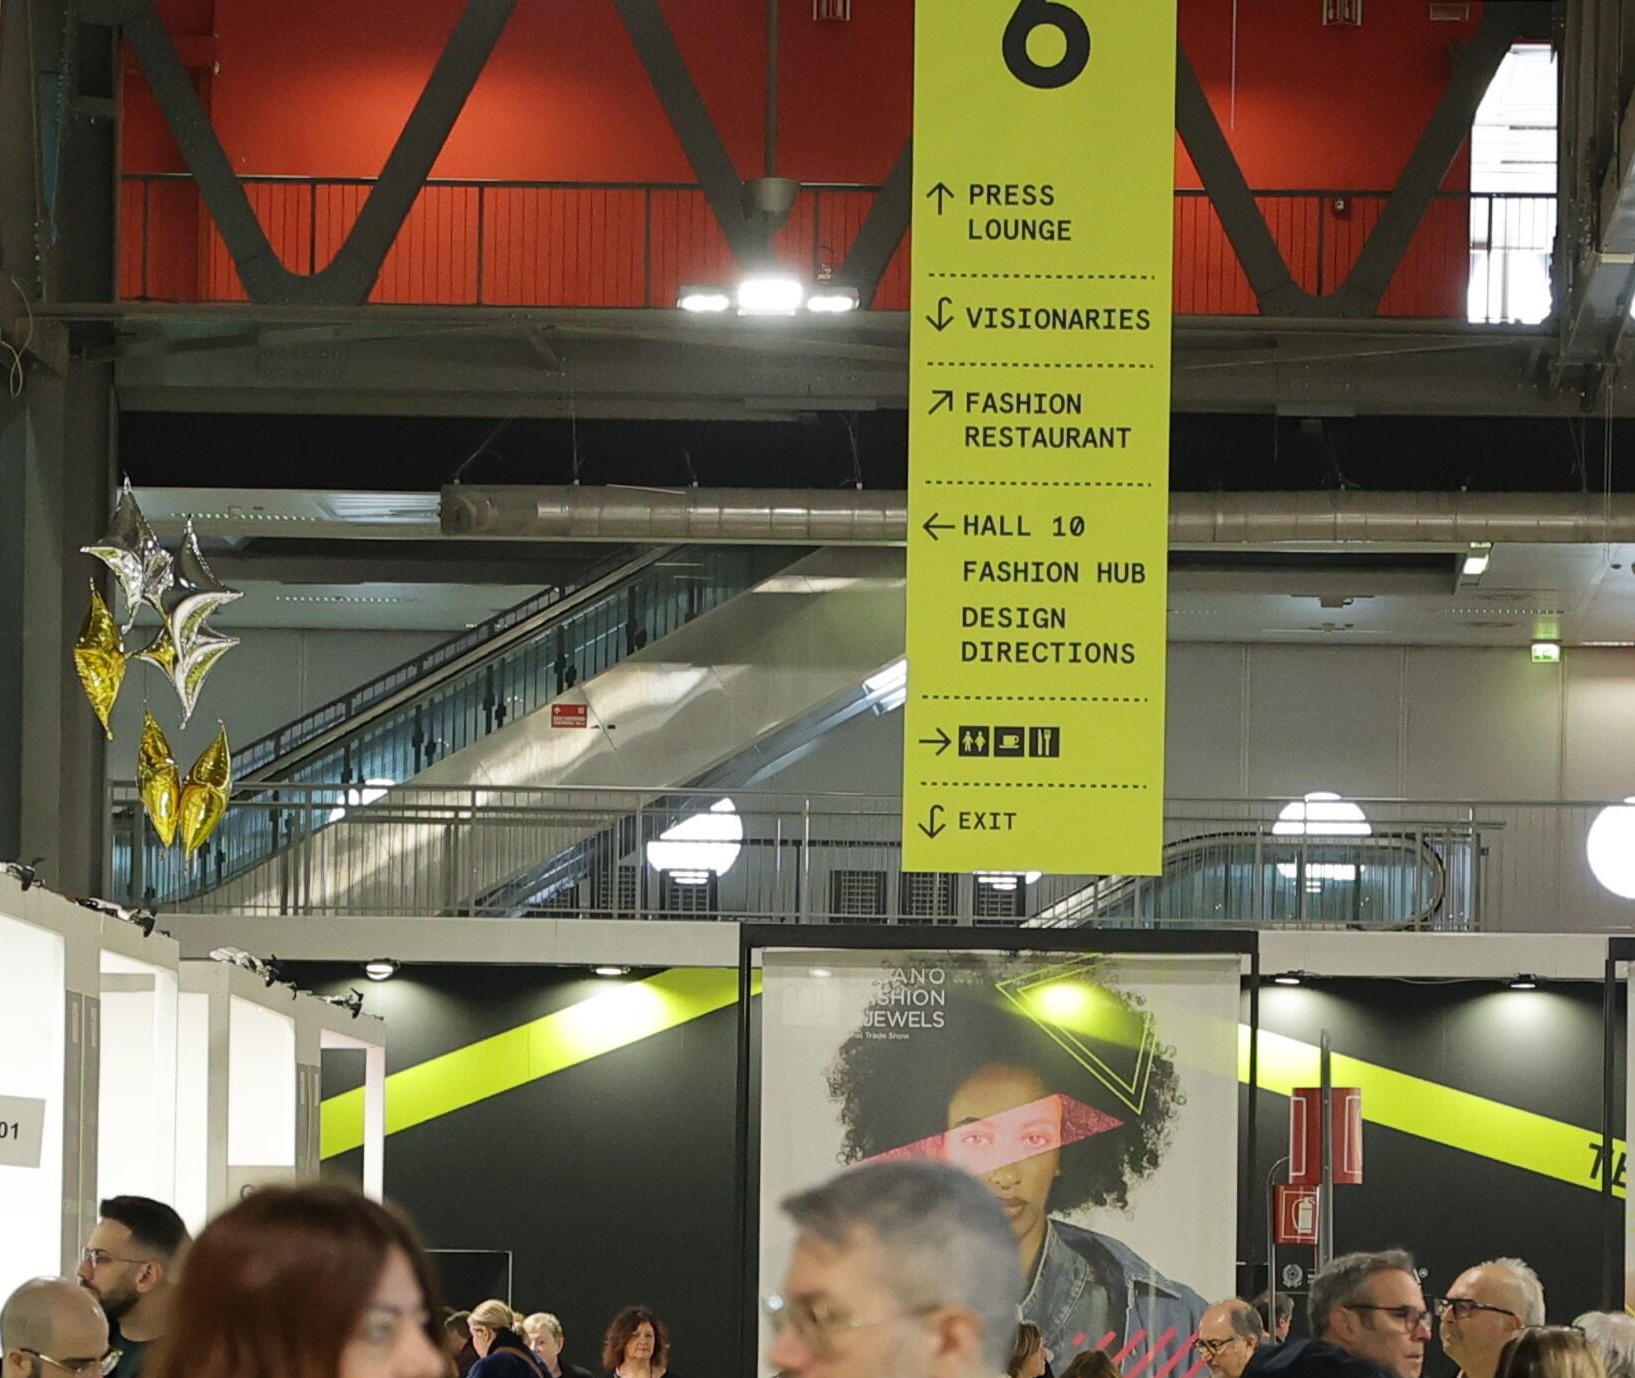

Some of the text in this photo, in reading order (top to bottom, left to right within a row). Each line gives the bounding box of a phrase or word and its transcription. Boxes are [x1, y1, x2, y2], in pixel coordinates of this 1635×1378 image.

[969, 184, 1055, 206] PRESS
[968, 219, 1071, 241] LOUNGE
[966, 307, 1150, 330] VISIONARIES
[966, 392, 1082, 414] FASHION
[965, 426, 1132, 449] RESTAURANT
[963, 515, 1085, 537] HALL 10
[963, 561, 1146, 584] FASHION HUB
[962, 607, 1066, 629] DESIGN
[961, 641, 1135, 664] DIRECTIONS
[958, 812, 1017, 831] EXIT
